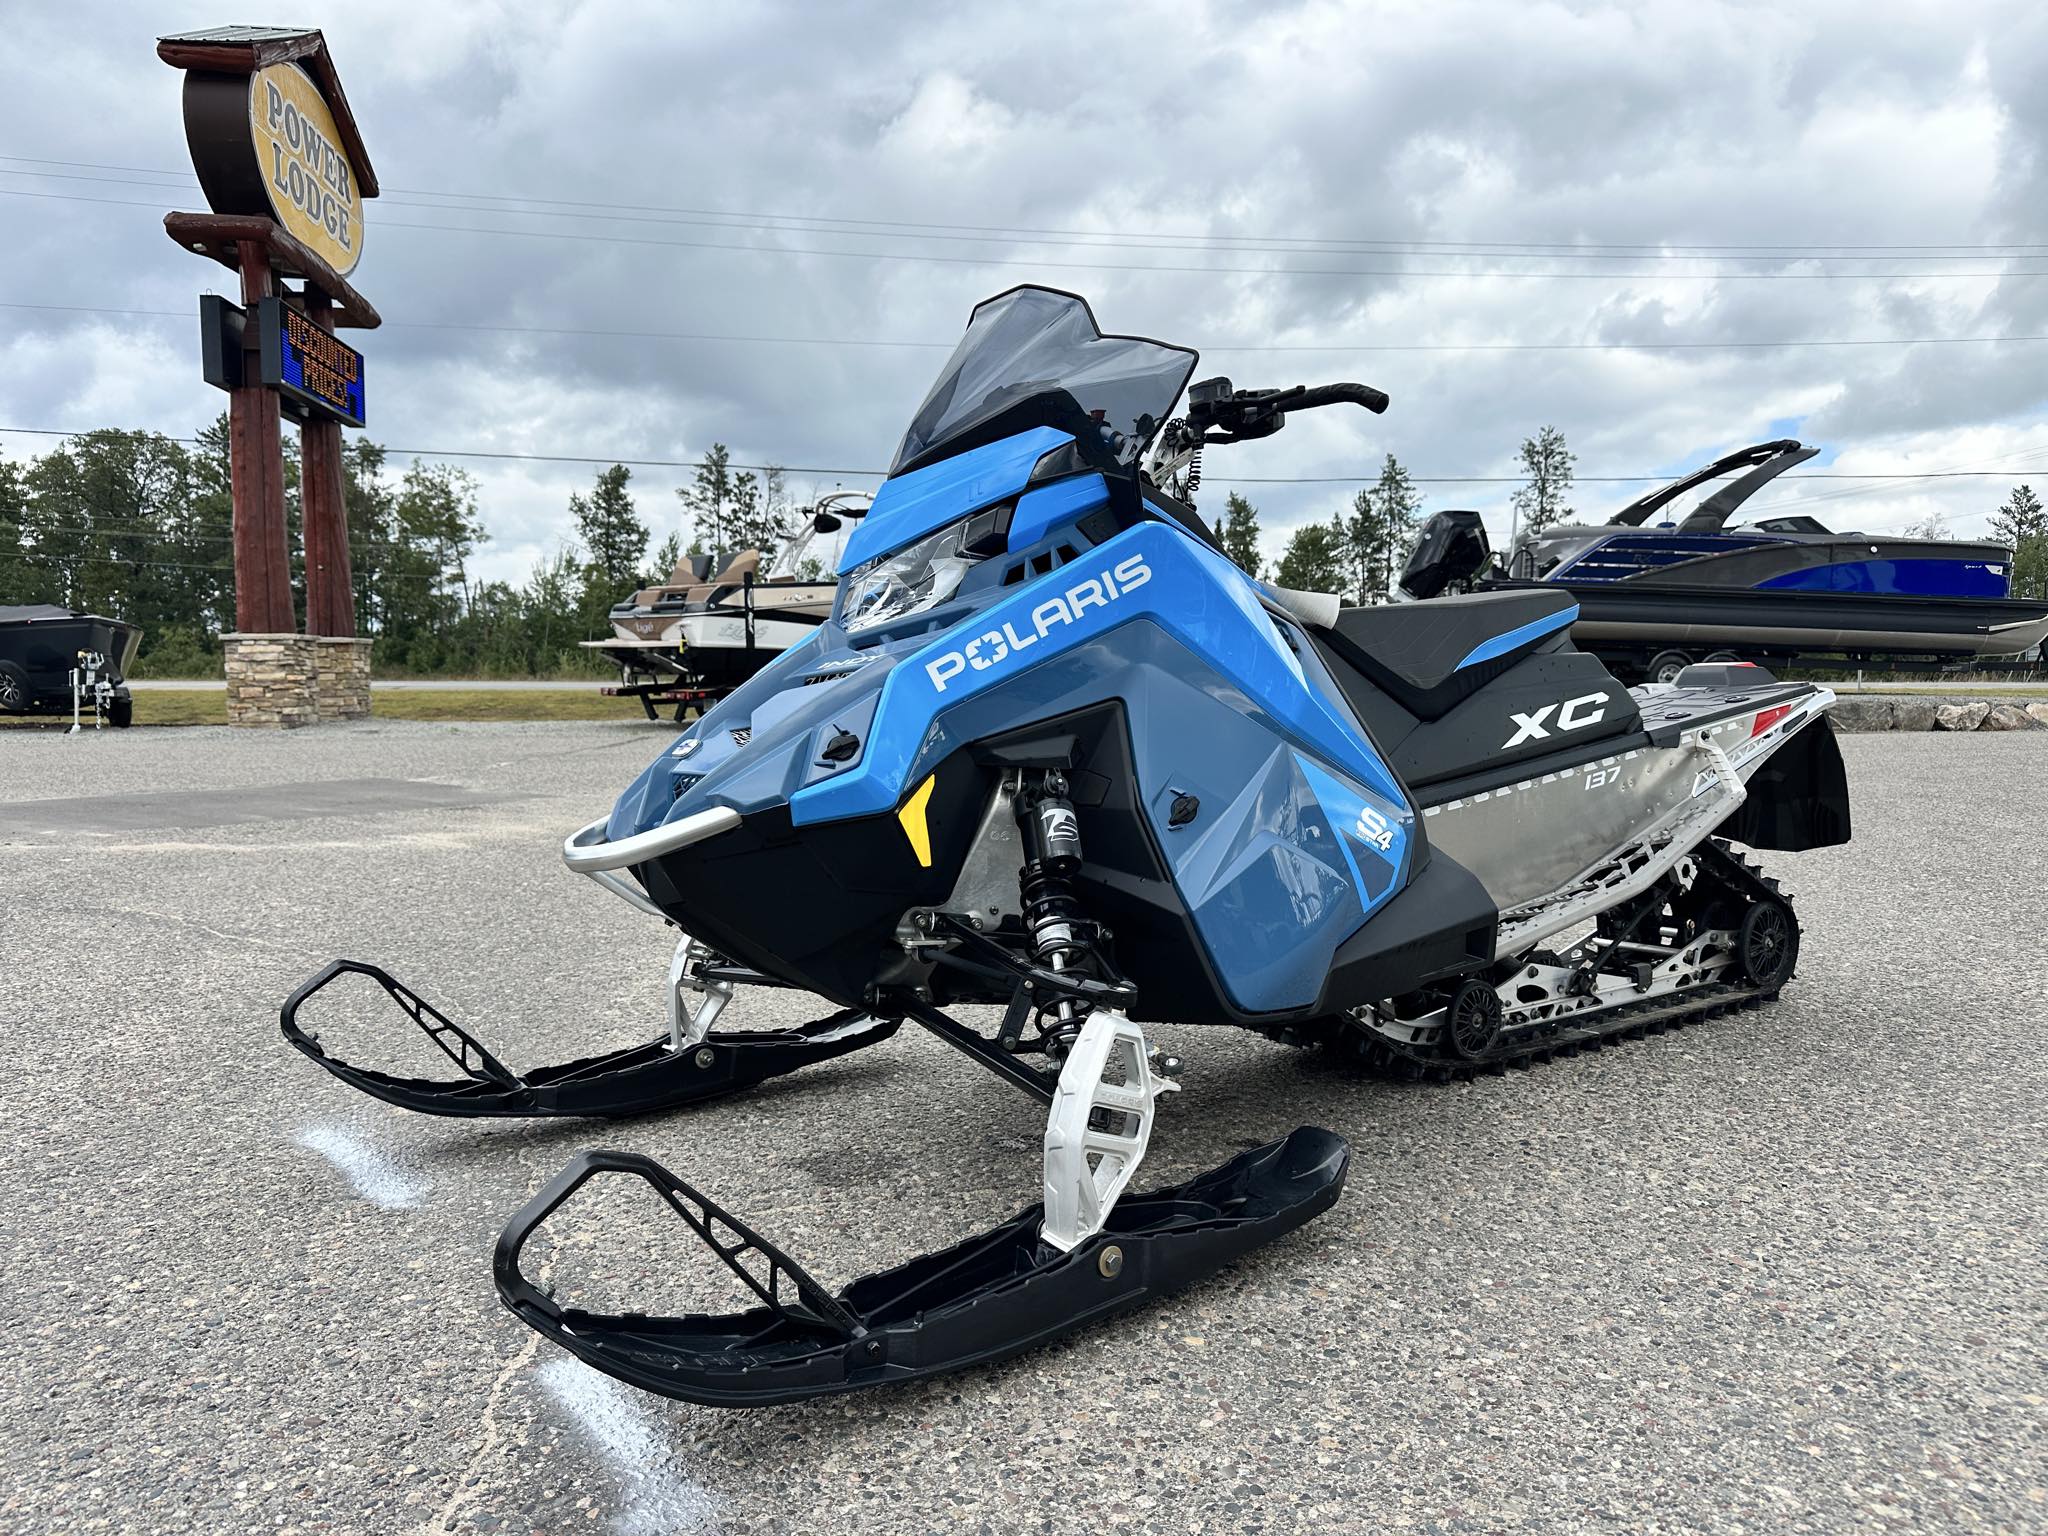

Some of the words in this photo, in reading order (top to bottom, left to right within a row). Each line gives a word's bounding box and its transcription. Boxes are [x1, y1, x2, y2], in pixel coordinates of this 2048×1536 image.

[267, 81, 351, 205] POWER
[273, 142, 350, 249] LODGE
[287, 310, 357, 383] DISCOUNTED
[925, 553, 1152, 693] POLARIS
[1501, 692, 1609, 749] XC
[1584, 765, 1621, 790] 137
